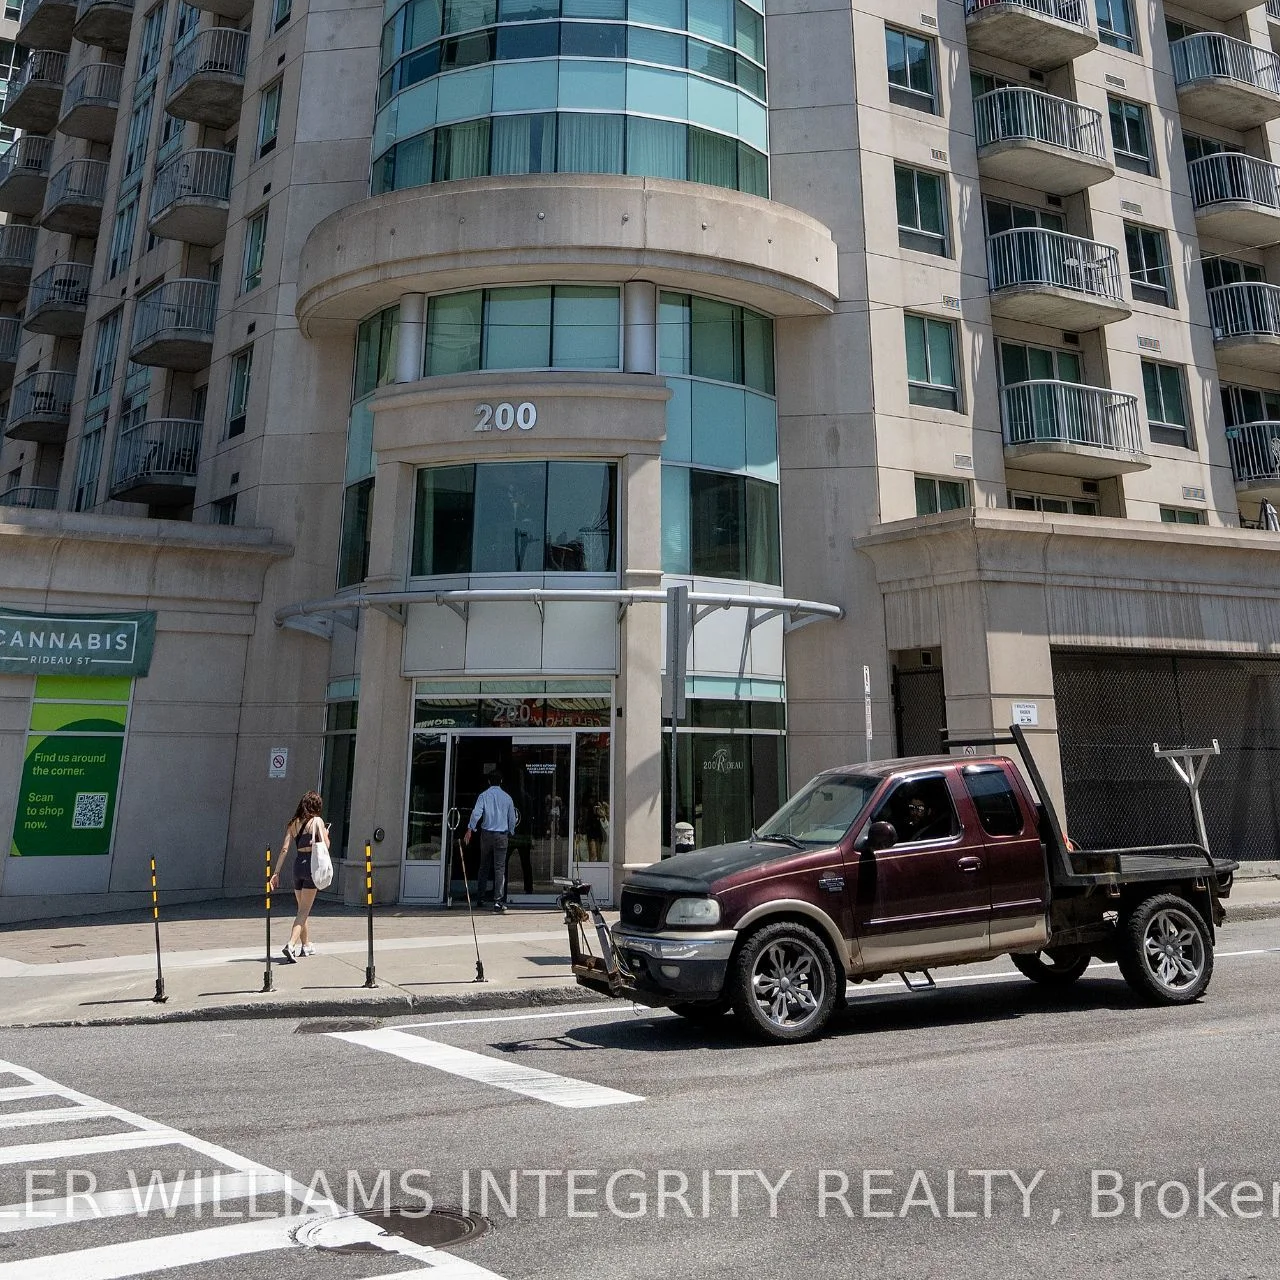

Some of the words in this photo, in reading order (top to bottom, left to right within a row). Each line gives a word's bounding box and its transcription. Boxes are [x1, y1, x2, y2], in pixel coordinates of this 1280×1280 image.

[473, 402, 537, 432] 200
[30, 656, 73, 665] RIDEAU
[77, 657, 92, 665] ST
[493, 704, 532, 722] 200
[34, 752, 57, 762] Find
[58, 754, 70, 762] us
[71, 753, 107, 763] around
[703, 761, 716, 770] 200
[32, 766, 50, 776] the
[50, 767, 86, 776] corner.
[28, 792, 54, 802] Scan
[26, 807, 37, 816] to
[38, 806, 64, 817] shop
[24, 820, 48, 829] now.
